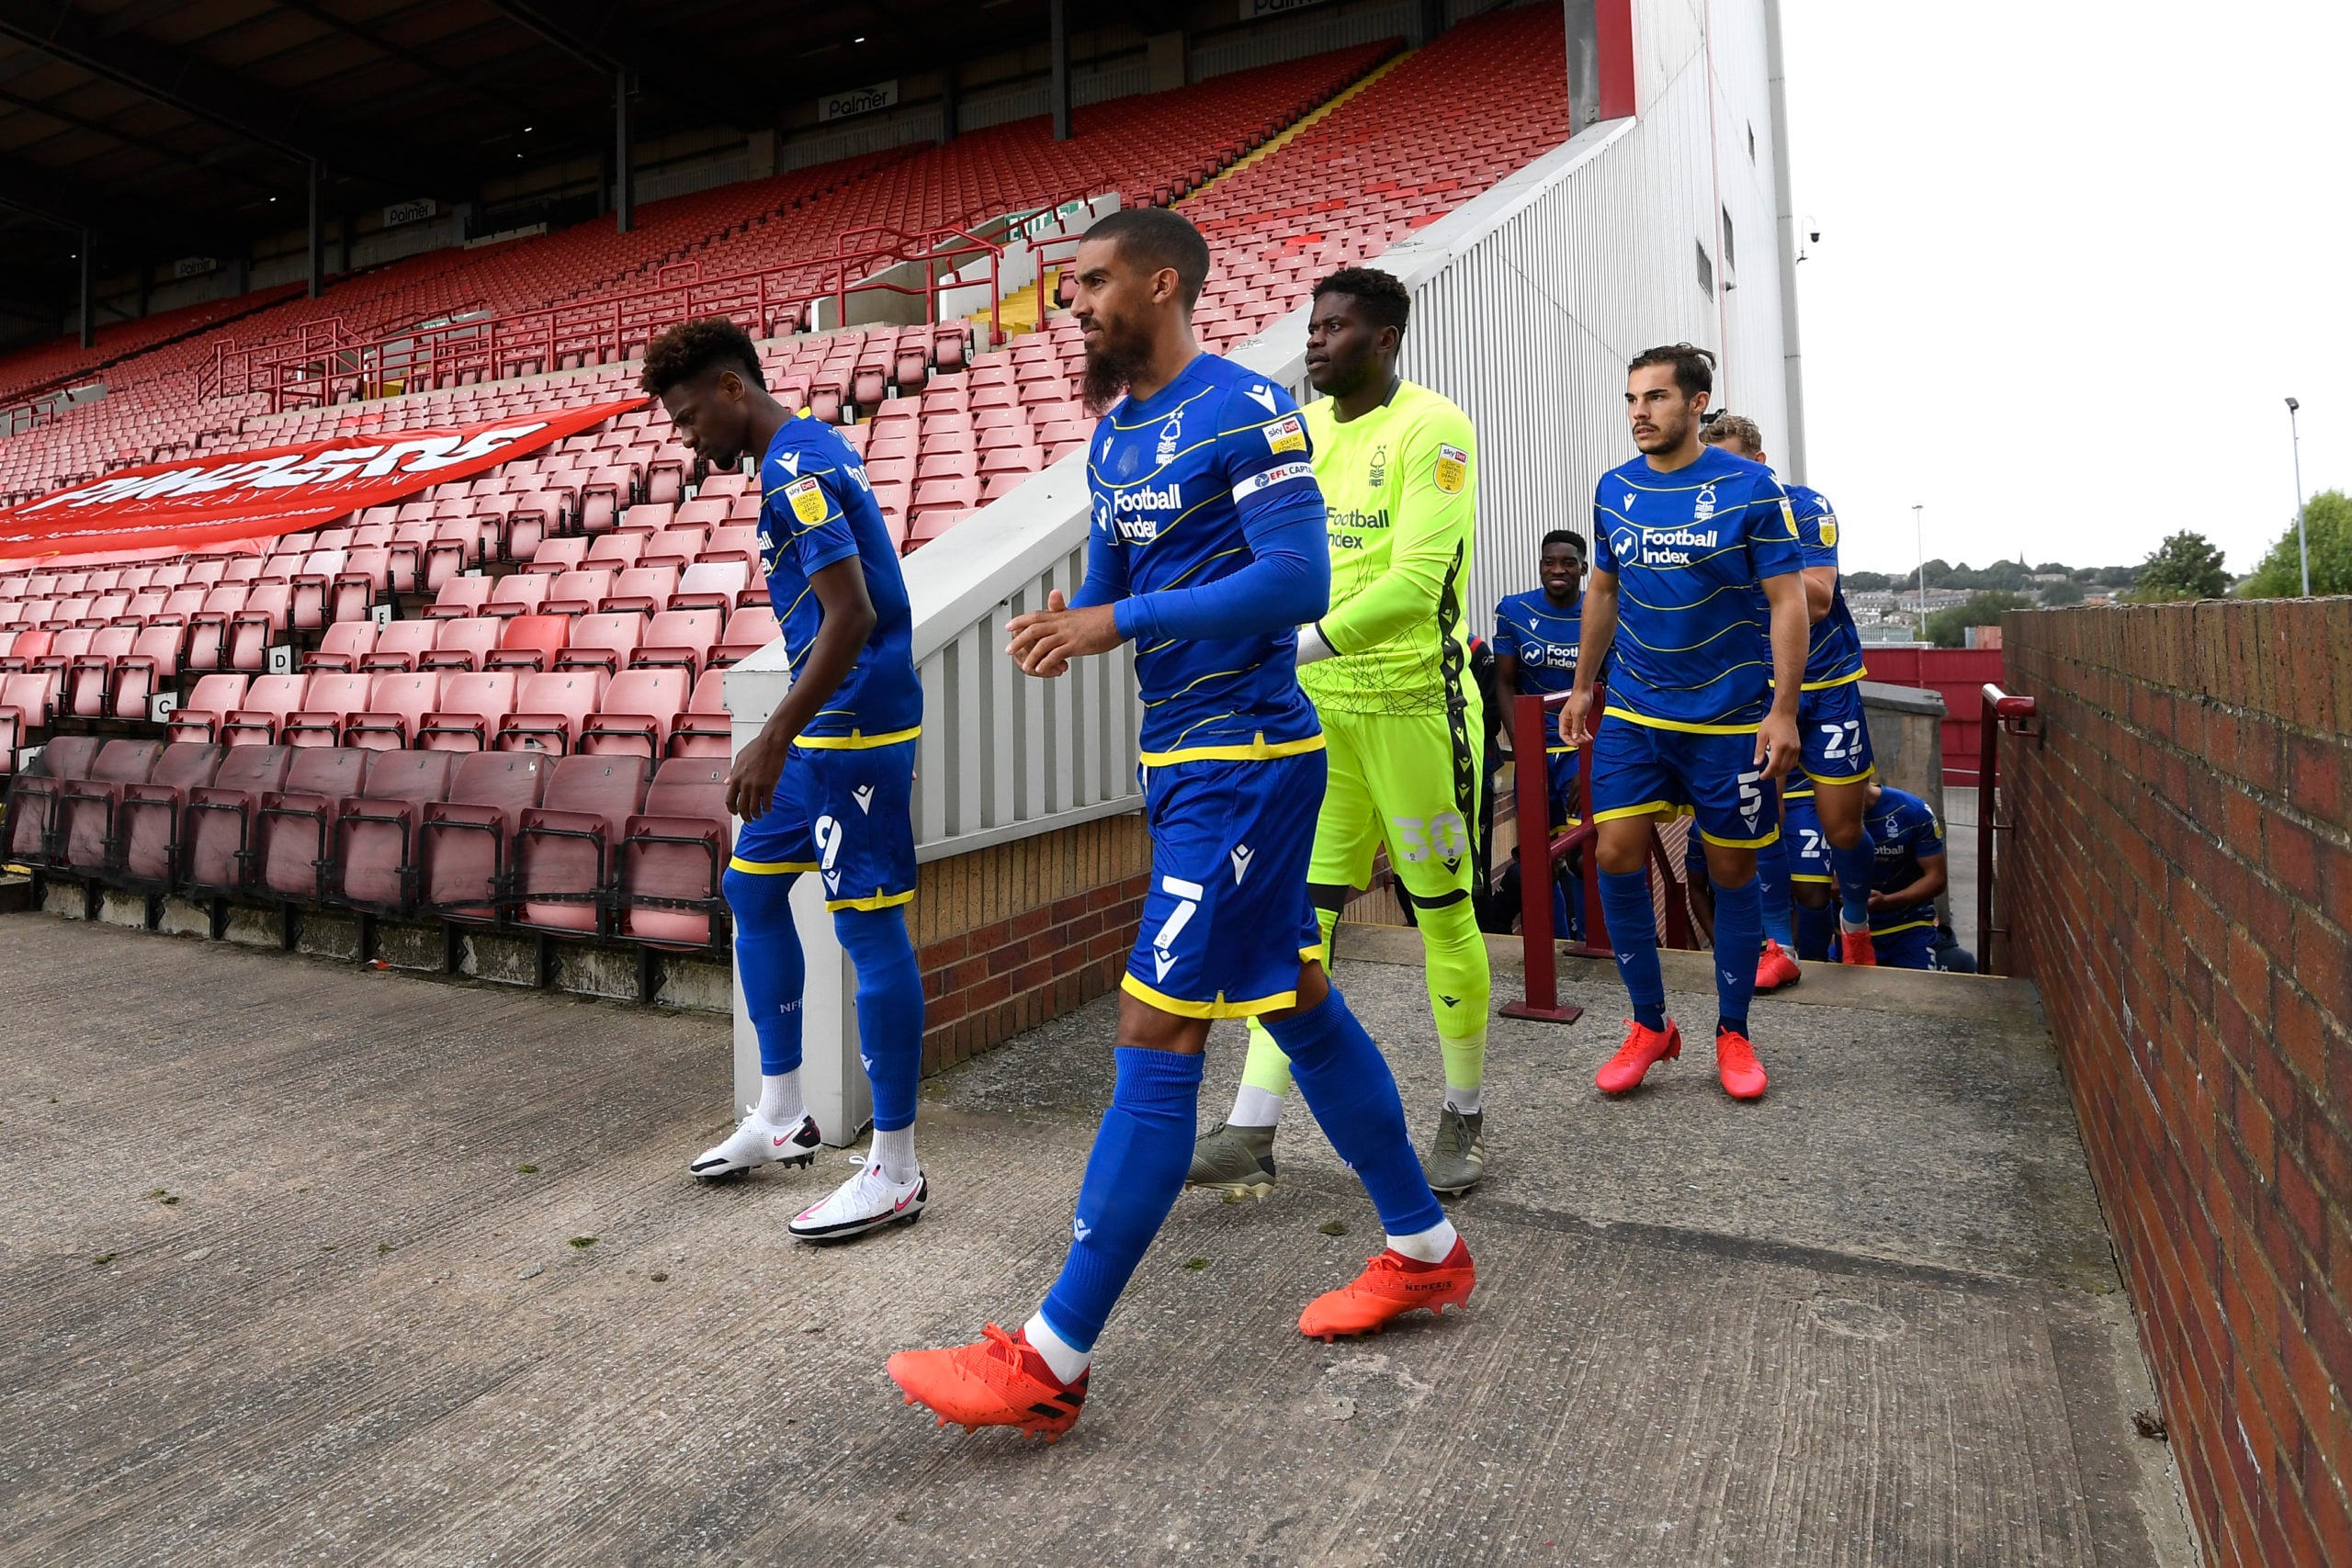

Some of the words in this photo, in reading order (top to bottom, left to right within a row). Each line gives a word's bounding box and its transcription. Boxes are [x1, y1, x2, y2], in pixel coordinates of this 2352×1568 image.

[829, 91, 888, 118] Palmer
[390, 204, 429, 224] Palmer
[1268, 427, 1283, 438] sky
[1443, 448, 1454, 457] sky
[1270, 469, 1287, 480] EFL
[1289, 466, 1312, 474] CAPTA
[788, 487, 800, 495] sky
[1114, 484, 1182, 514] Football
[1115, 514, 1158, 538] Index
[1326, 507, 1389, 528] Football
[1328, 529, 1363, 549] ndex
[1643, 528, 1718, 547] Football
[1643, 547, 1690, 564] Index
[379, 613, 385, 625] E
[275, 654, 286, 668] D
[1547, 645, 1578, 658] Foot
[158, 700, 171, 715] C
[1737, 770, 1762, 816] 5
[815, 815, 842, 870] 9
[1393, 811, 1466, 863] 30
[1874, 845, 1904, 855] otball
[1152, 874, 1204, 950] 7
